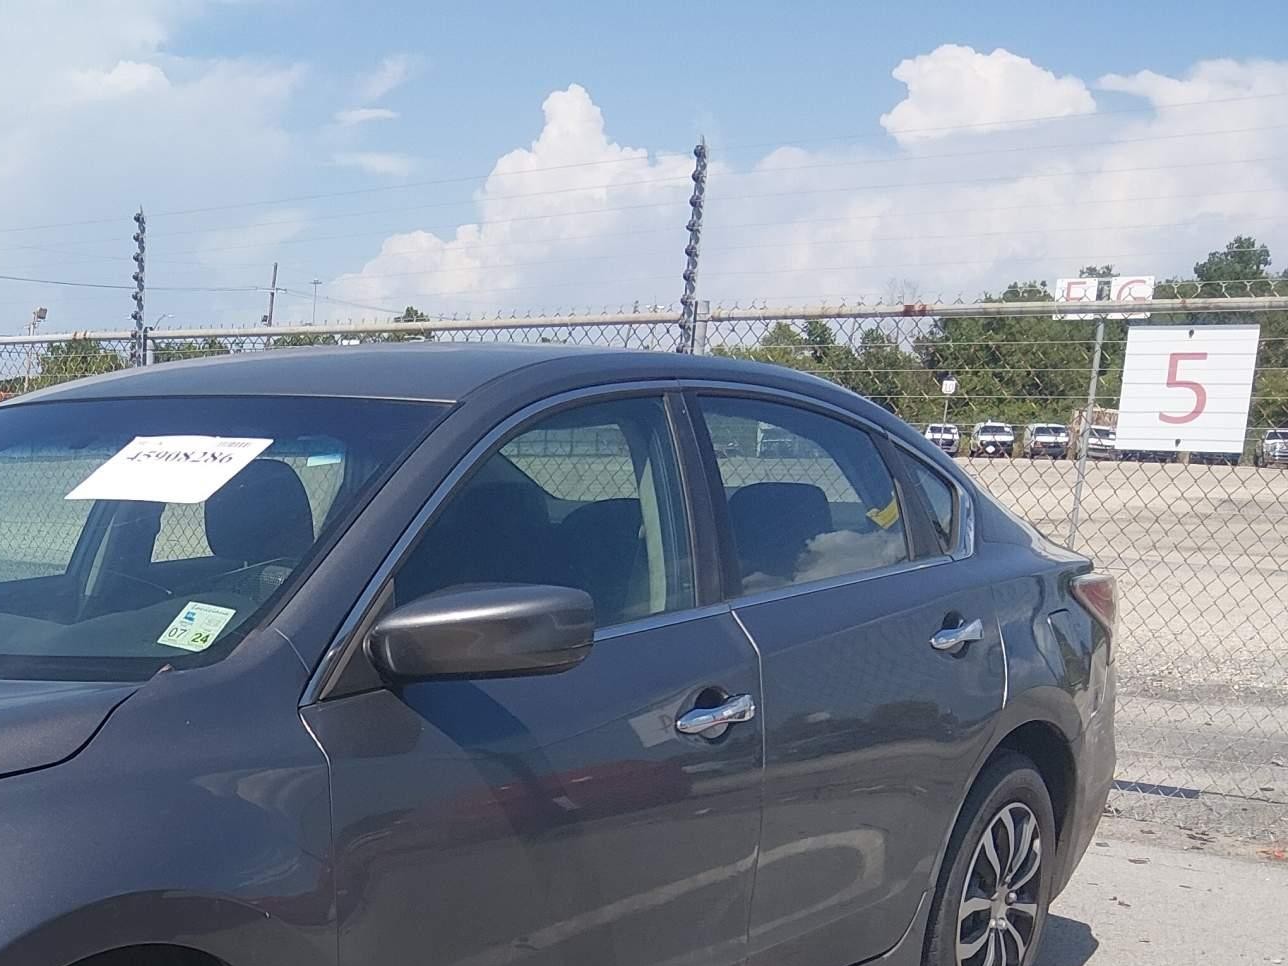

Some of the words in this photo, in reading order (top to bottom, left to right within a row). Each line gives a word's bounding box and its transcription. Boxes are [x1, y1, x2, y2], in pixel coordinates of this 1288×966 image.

[1158, 352, 1208, 425] 5
[126, 450, 234, 463] 45908286
[168, 627, 187, 639] 07
[191, 632, 210, 644] 24
